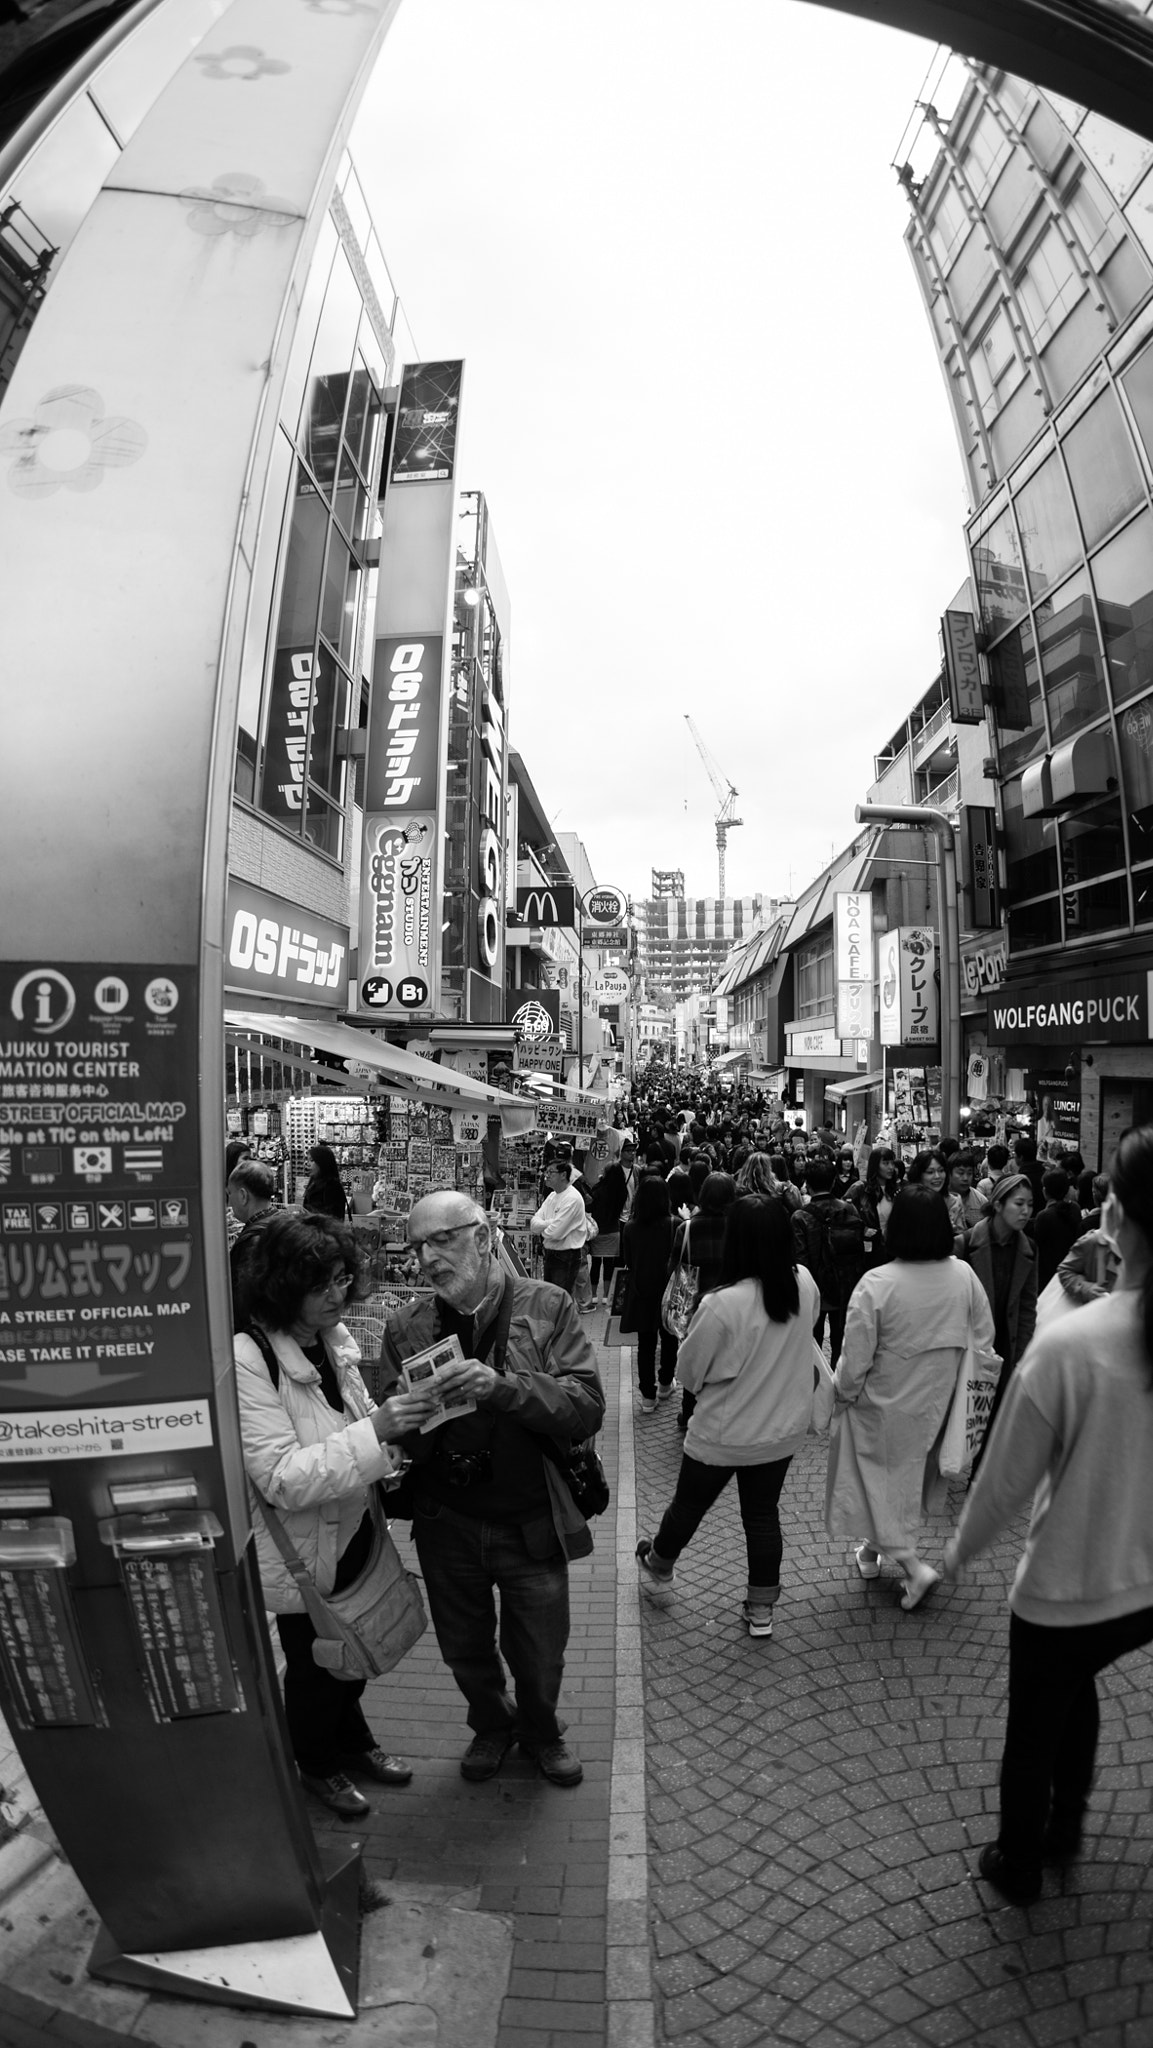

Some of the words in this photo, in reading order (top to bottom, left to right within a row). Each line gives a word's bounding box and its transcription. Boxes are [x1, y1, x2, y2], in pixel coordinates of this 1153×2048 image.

[952, 615, 977, 704] コインロッカー
[961, 707, 982, 717] 3F
[384, 643, 425, 806] OSドラッグ
[401, 856, 421, 895] プリ
[418, 858, 431, 967] ENTERTAINMENT
[591, 900, 619, 913] 消火栓
[847, 896, 861, 928] NOA
[404, 897, 415, 946] STUDIO
[229, 910, 345, 988] OSドラッグ
[848, 933, 860, 978] CAFE
[402, 985, 423, 1001] B1
[605, 980, 627, 991] Pausa
[910, 956, 928, 1024] クレープ
[911, 1025, 929, 1034] 原宿
[55, 1042, 130, 1058] TOURIST
[520, 1045, 562, 1056] ハッピーワン
[73, 1062, 140, 1077] CENTER
[520, 1058, 544, 1069] HAPPY
[545, 1060, 561, 1071] ONE
[0, 1104, 65, 1123] STREET
[66, 1103, 144, 1122] OFFICIAL
[144, 1102, 186, 1121] MAP
[1054, 1101, 1076, 1112] LUNCH
[537, 1122, 563, 1130] CARVING
[538, 1111, 597, 1129] 文字入れ無料
[27, 1129, 45, 1144] at
[49, 1127, 76, 1143] TIC
[79, 1131, 99, 1143] on
[103, 1127, 130, 1142] the
[133, 1125, 174, 1142] Left!
[6, 1209, 27, 1218] TAX
[5, 1218, 30, 1229] FREE
[15, 1310, 76, 1324] STREET
[80, 1305, 153, 1320] OFFICIAL
[157, 1303, 191, 1316] MAP
[30, 1347, 72, 1361] TAKE
[76, 1345, 91, 1359] IT
[96, 1342, 155, 1358] FREELY
[0, 1410, 204, 1442] @takeshita-street
